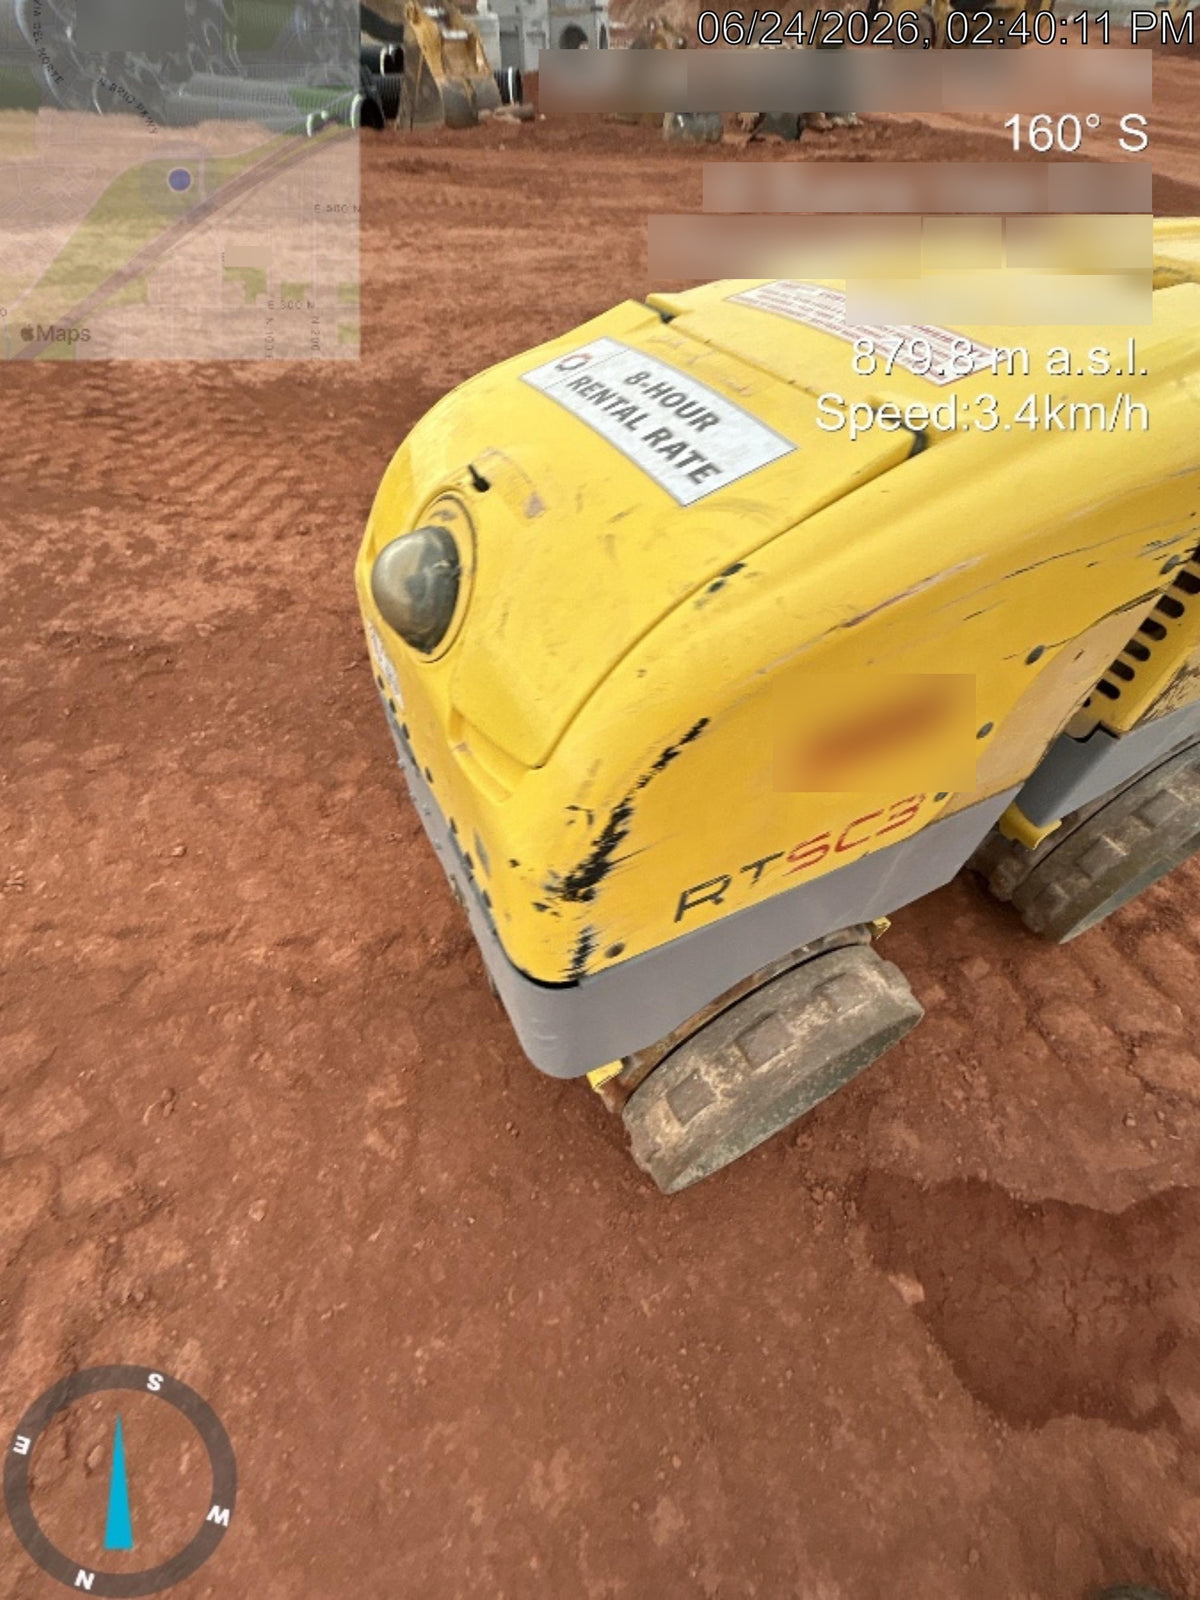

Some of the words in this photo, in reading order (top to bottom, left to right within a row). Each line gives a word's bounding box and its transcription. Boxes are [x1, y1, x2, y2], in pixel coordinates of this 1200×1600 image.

[566, 375, 651, 431] RENTAL
[641, 426, 723, 485] RATE
[623, 370, 721, 433] 8-HOUR
